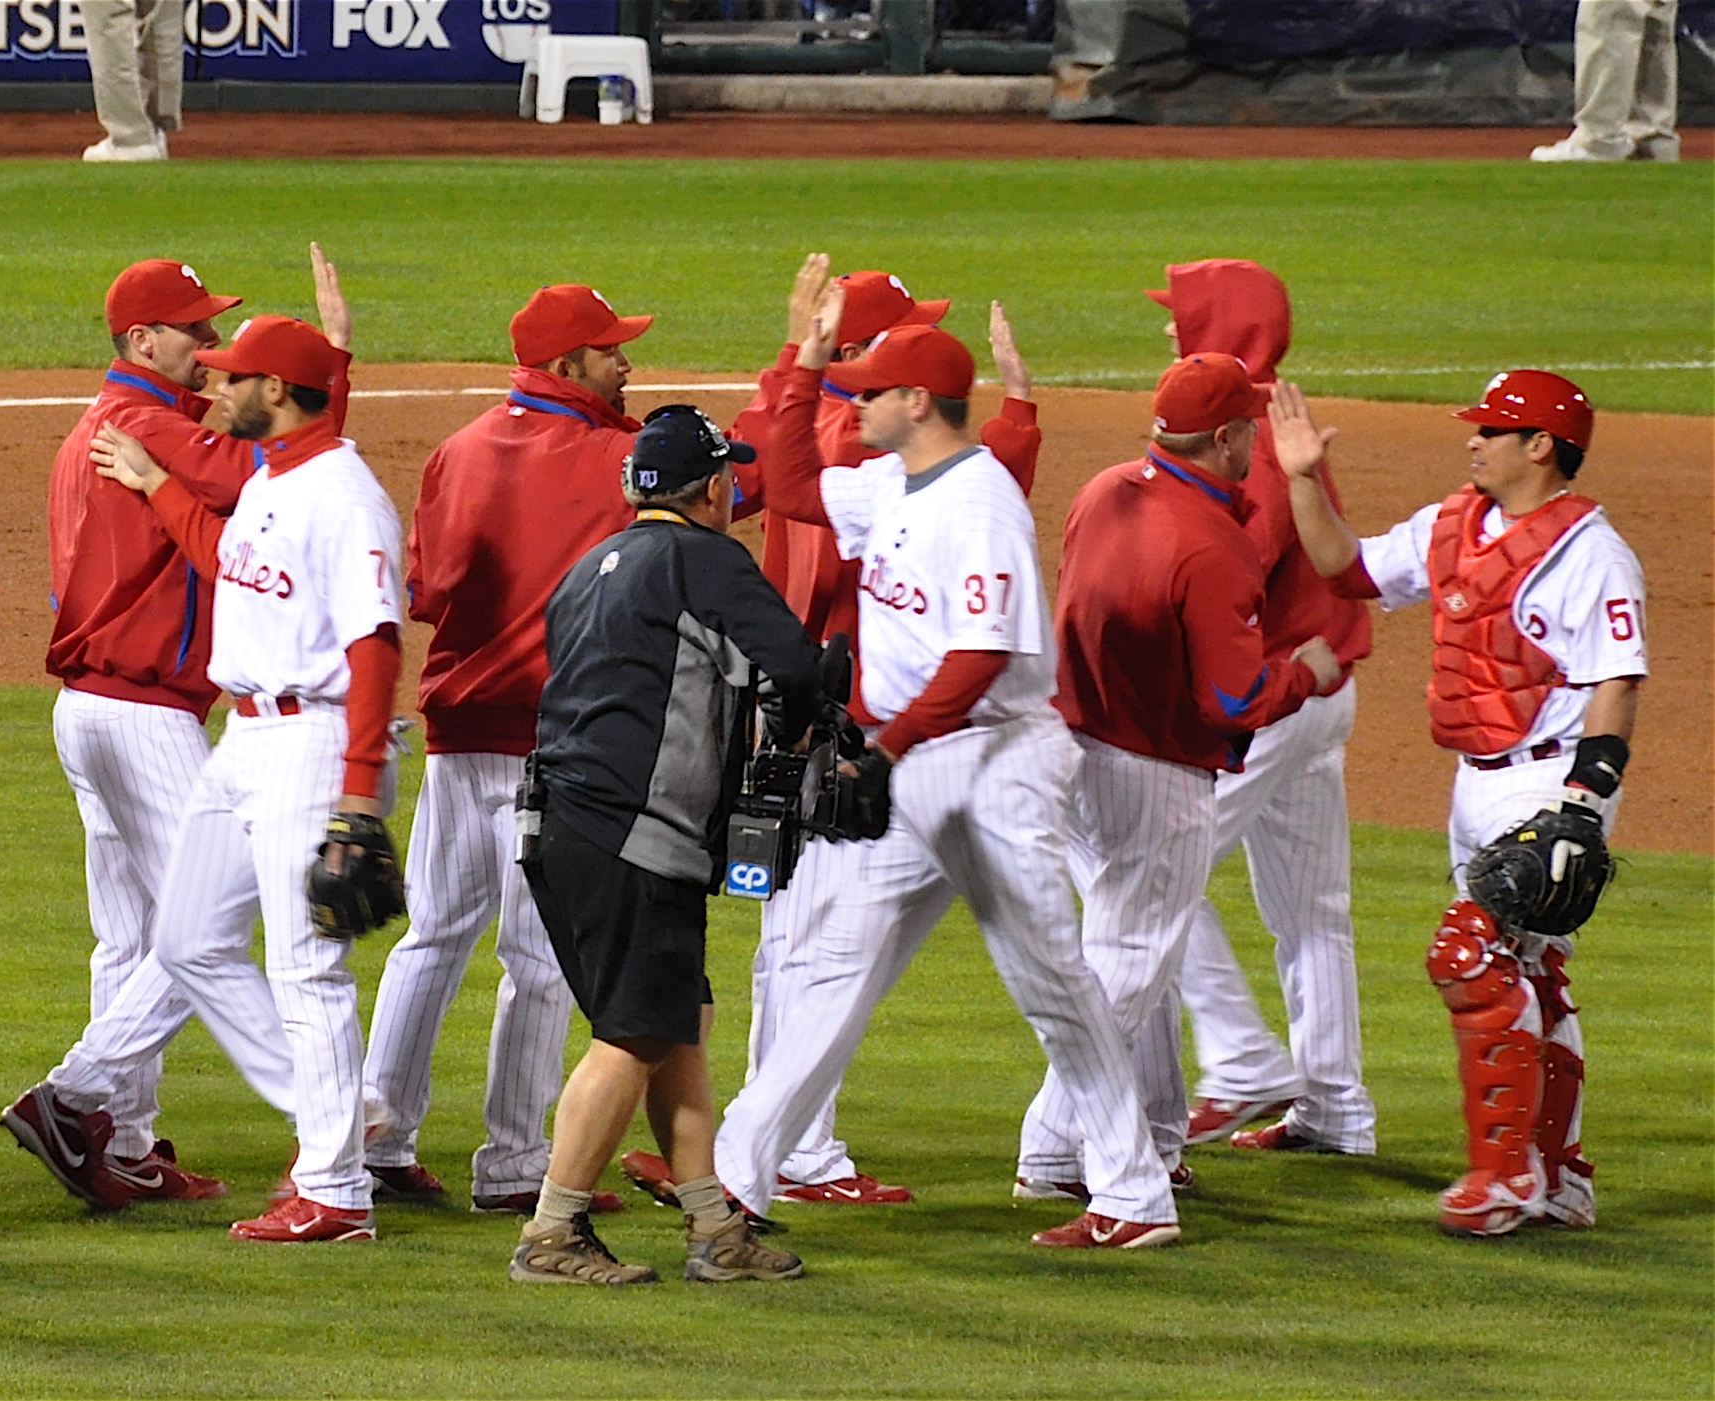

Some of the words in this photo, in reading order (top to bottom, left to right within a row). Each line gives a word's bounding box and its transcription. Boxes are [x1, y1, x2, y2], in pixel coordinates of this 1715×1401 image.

[332, 0, 450, 48] FOX
[369, 549, 387, 588] 7
[964, 573, 1012, 616] 37
[1606, 598, 1646, 642] 51
